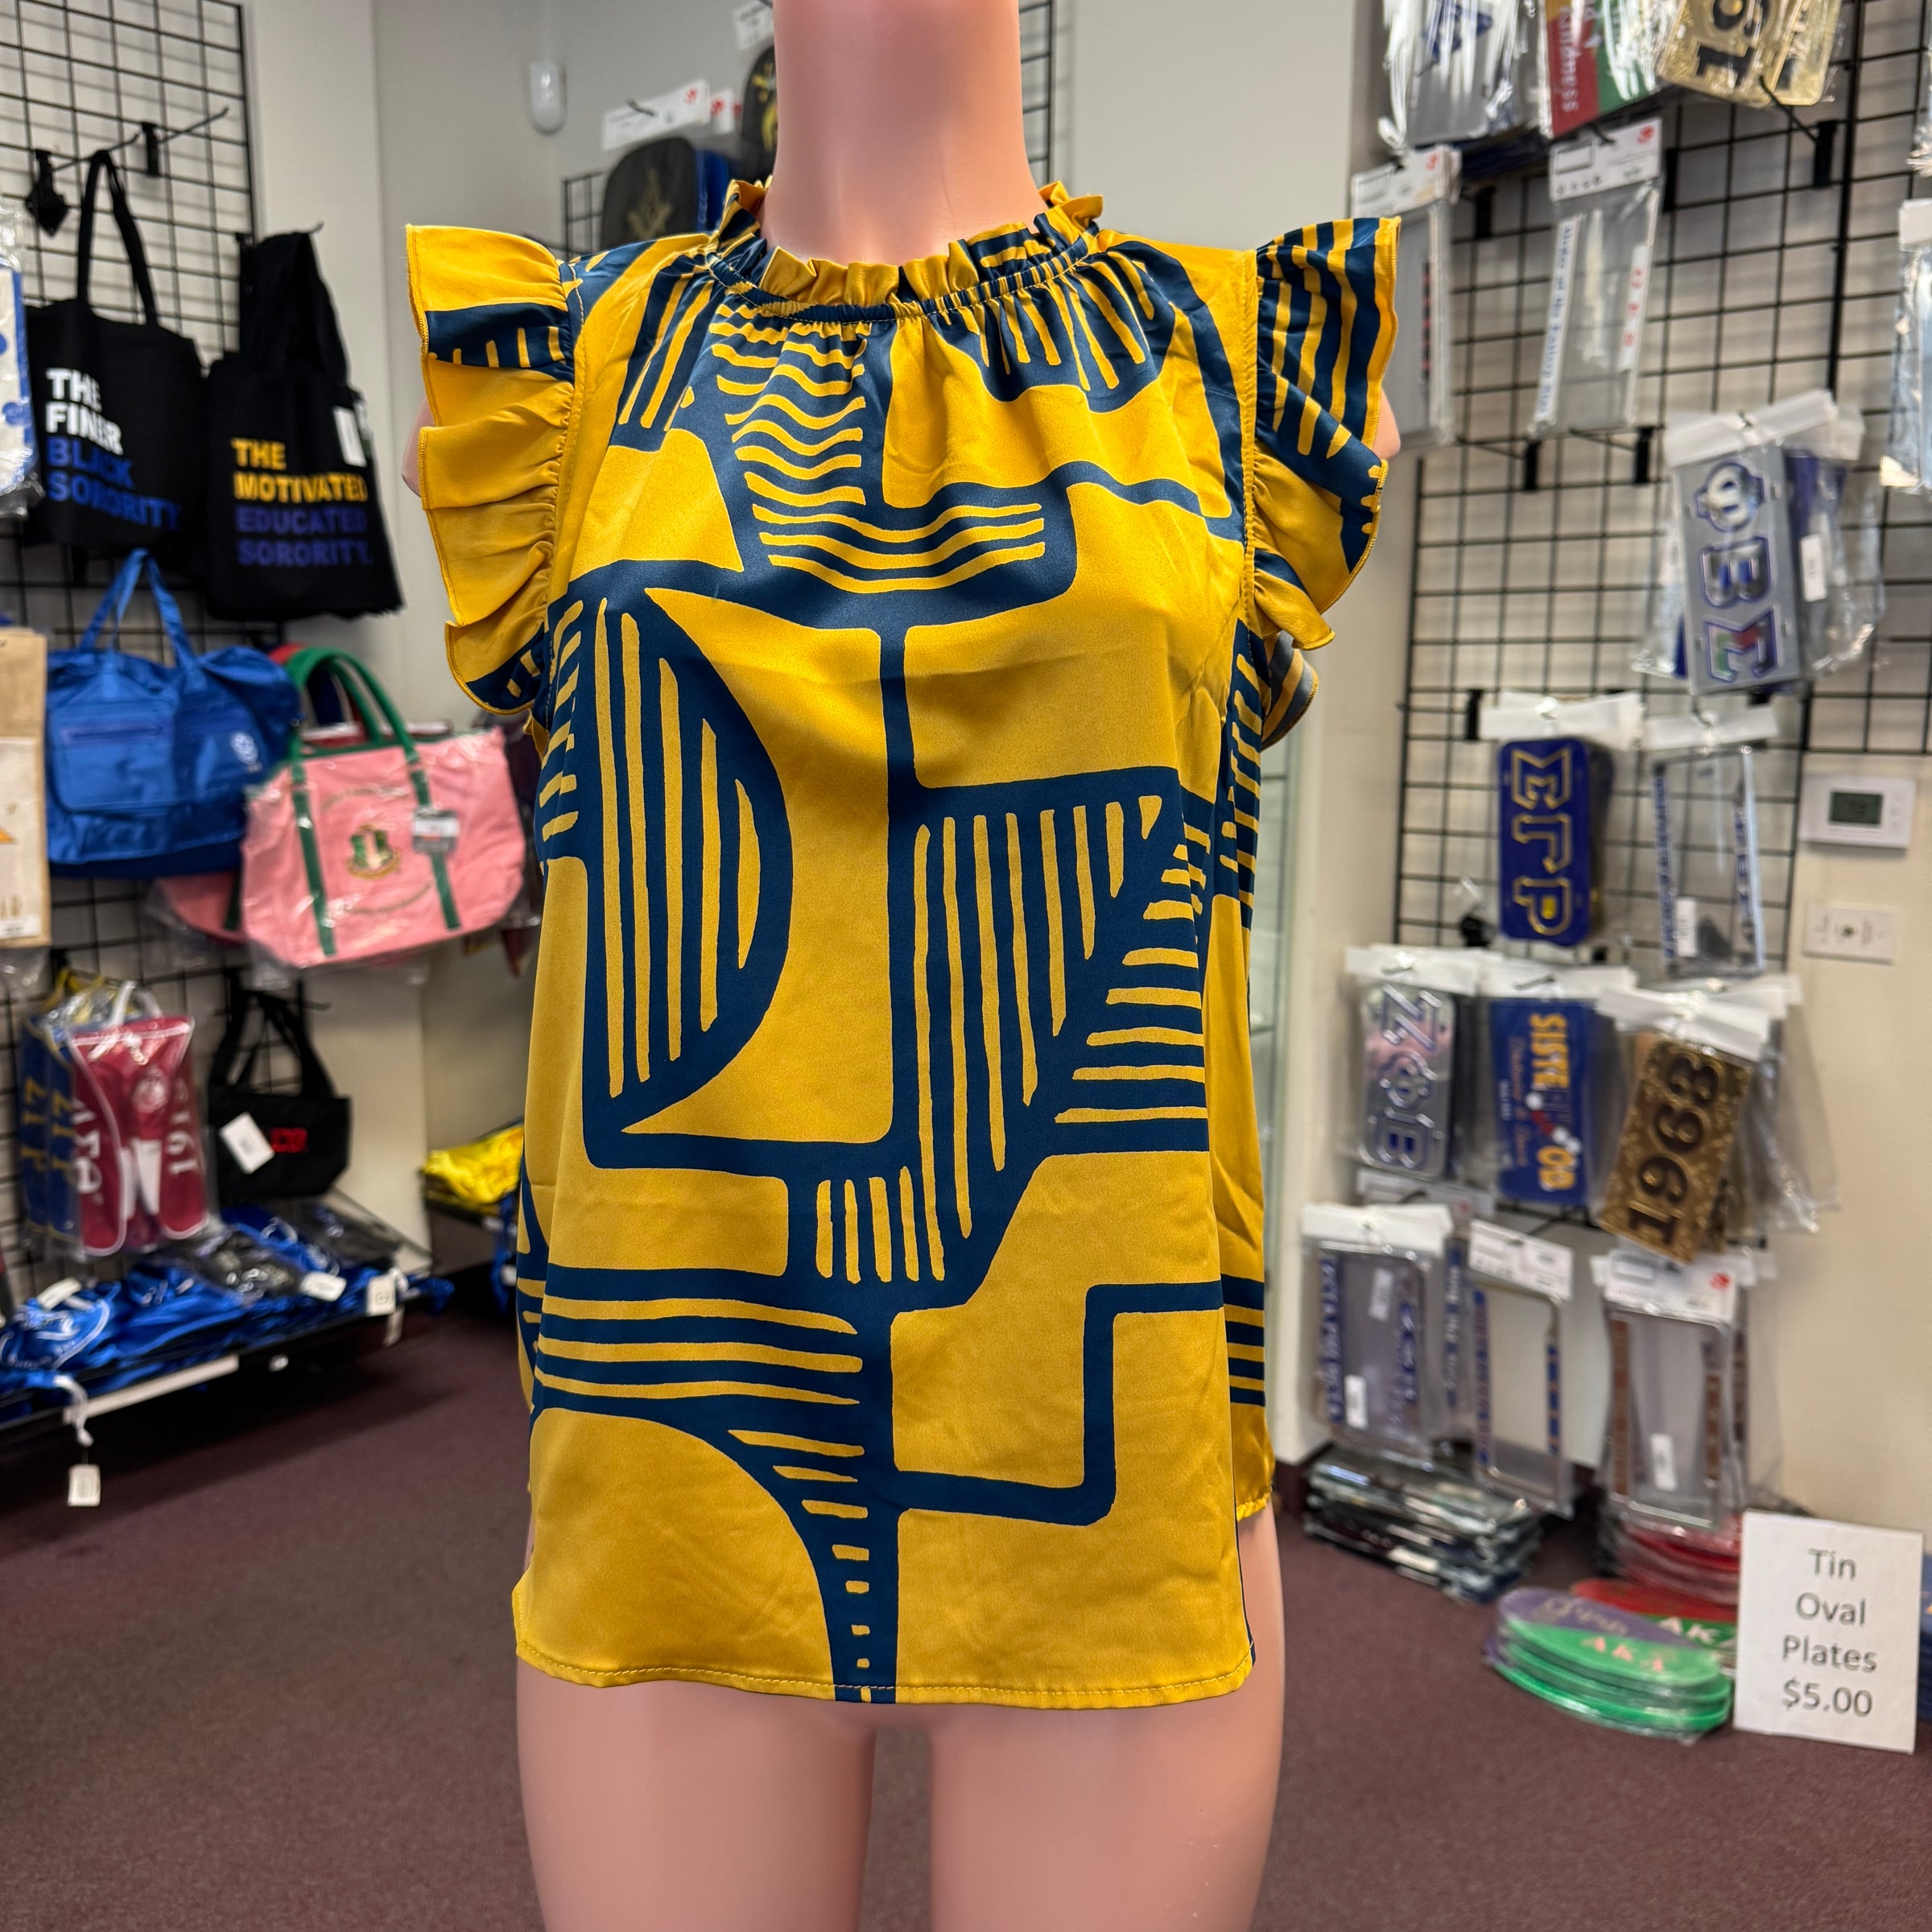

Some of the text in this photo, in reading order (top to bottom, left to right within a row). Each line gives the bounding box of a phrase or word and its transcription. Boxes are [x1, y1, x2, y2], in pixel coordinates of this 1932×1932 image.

[46, 368, 102, 412] THE
[230, 437, 287, 470] THE
[236, 505, 367, 535] EDUCATED
[1528, 1013, 1577, 1191] SISTEOD
[1809, 1548, 1857, 1581] Tin
[1796, 1591, 1867, 1627] Oval
[1782, 1634, 1878, 1674] Plates
[1781, 1675, 1874, 1718] $5.00
